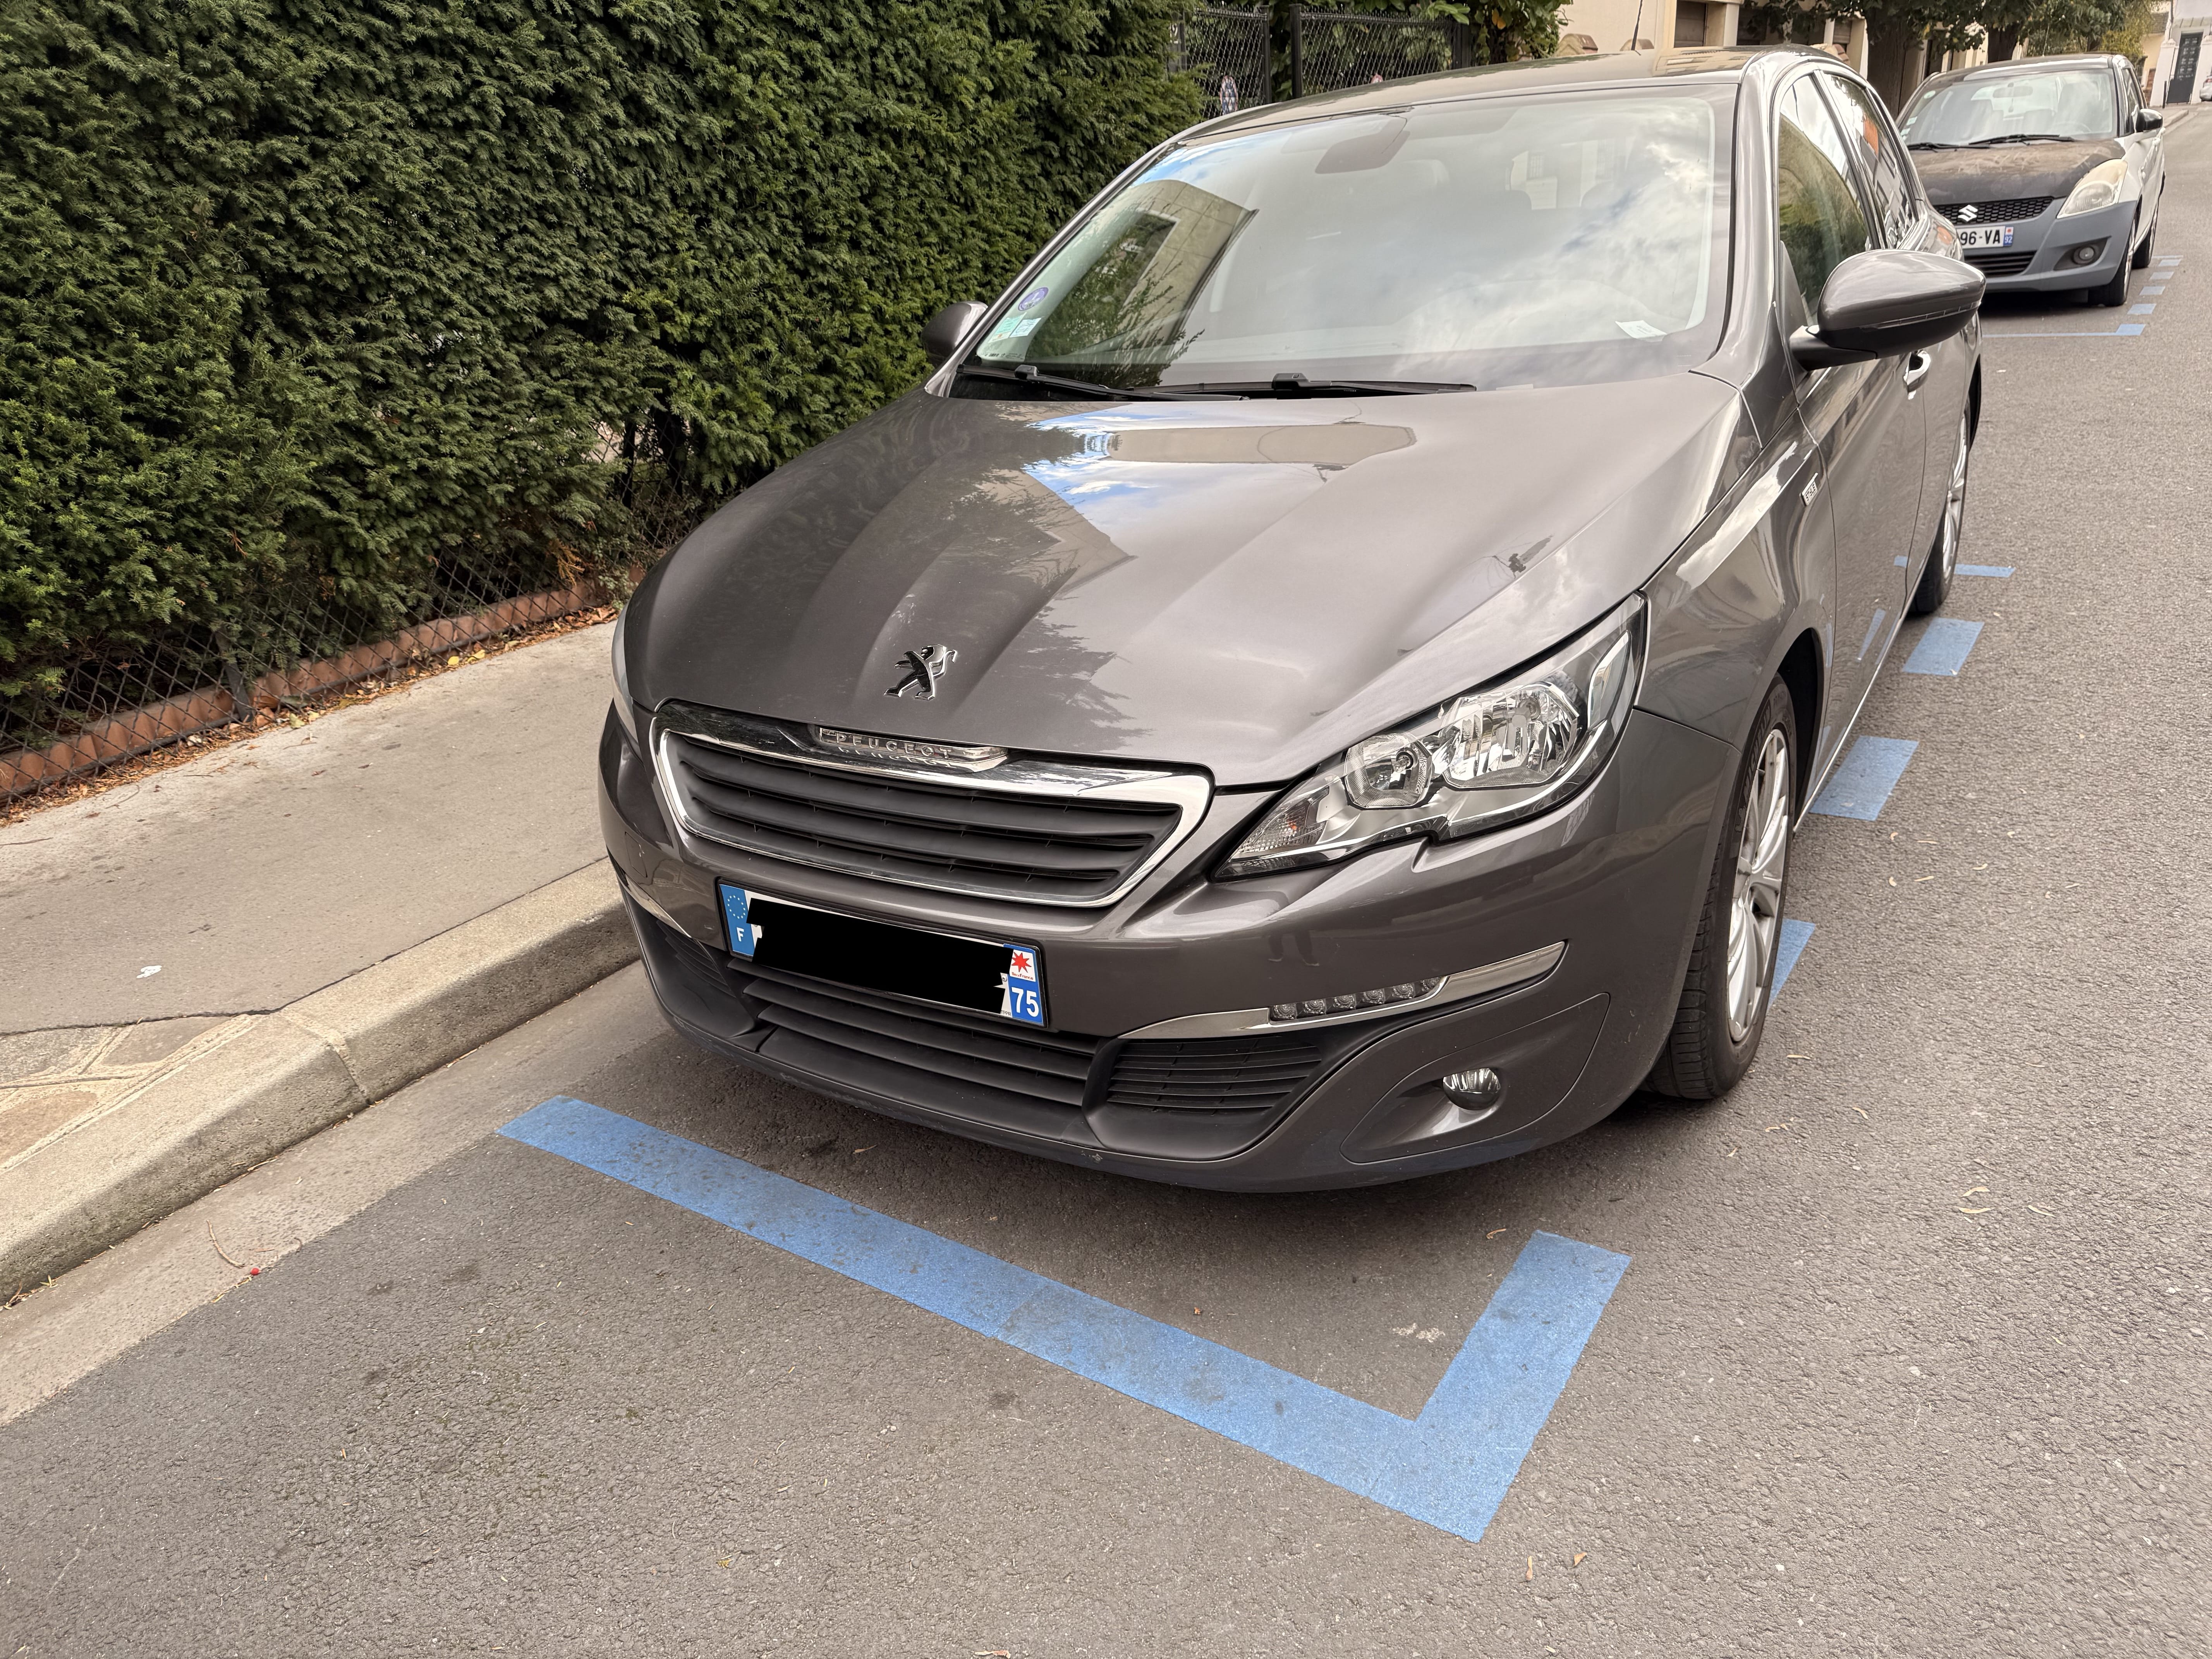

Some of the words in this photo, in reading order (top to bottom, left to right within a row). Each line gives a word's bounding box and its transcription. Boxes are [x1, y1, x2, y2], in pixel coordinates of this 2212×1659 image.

[1960, 229, 2000, 245] 96-VA
[2004, 235, 2012, 244] 92
[836, 733, 951, 759] PEUGEOT
[737, 927, 744, 942] F
[1012, 987, 1039, 1017] 75
